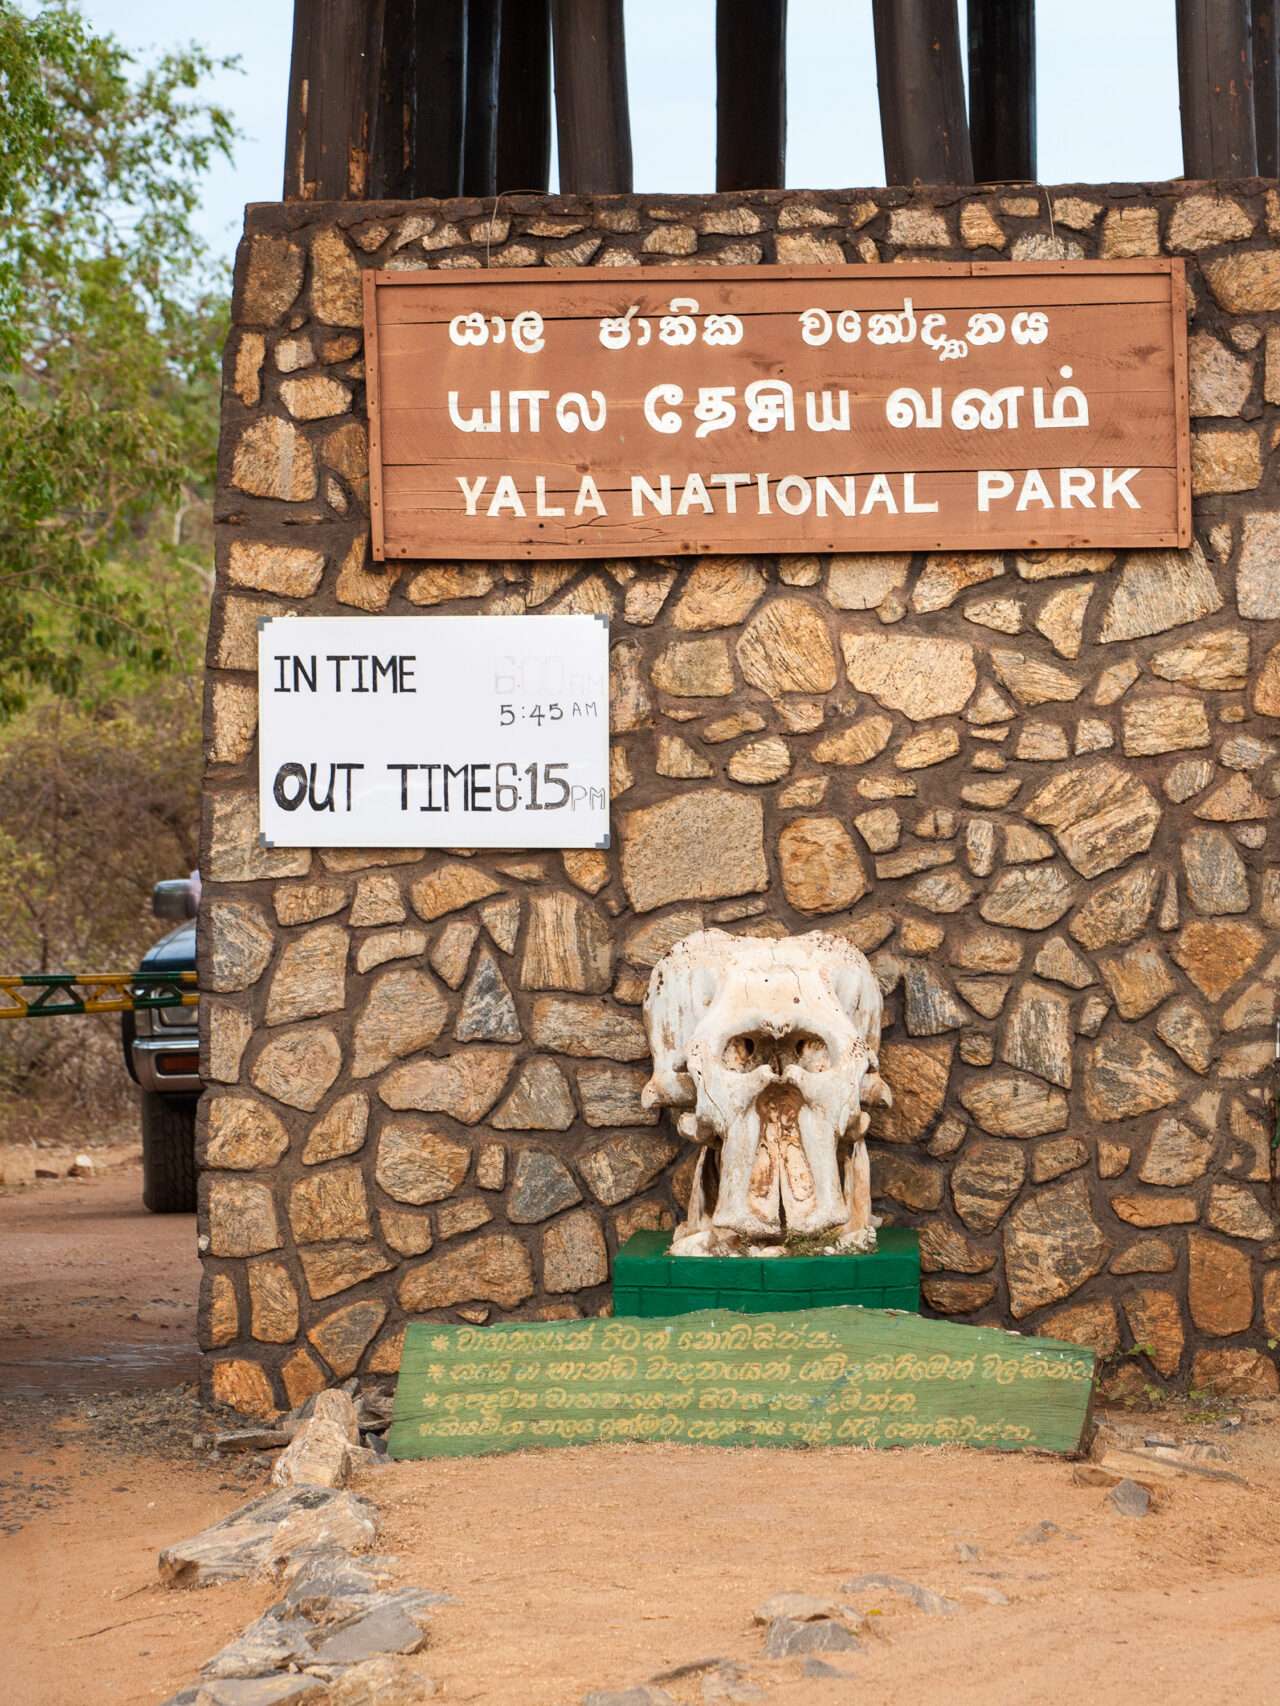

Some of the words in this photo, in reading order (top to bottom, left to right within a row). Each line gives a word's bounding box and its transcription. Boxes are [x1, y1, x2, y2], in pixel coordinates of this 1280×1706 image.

[448, 310, 545, 354] යාල
[598, 297, 744, 351] ජාතික
[447, 390, 608, 433] யால
[643, 379, 851, 438] தேசிய
[886, 365, 1090, 431] வனம்
[456, 475, 606, 518] YALA
[630, 472, 939, 518] NATIONAL
[976, 467, 1142, 513] PARK
[274, 655, 317, 693] IN
[326, 655, 417, 693] TIME
[500, 702, 564, 727] 5:45
[572, 701, 598, 718] AM
[273, 762, 365, 812] OUT
[387, 763, 492, 812] TIME
[495, 762, 571, 811] 6:15
[570, 784, 607, 810] PM
